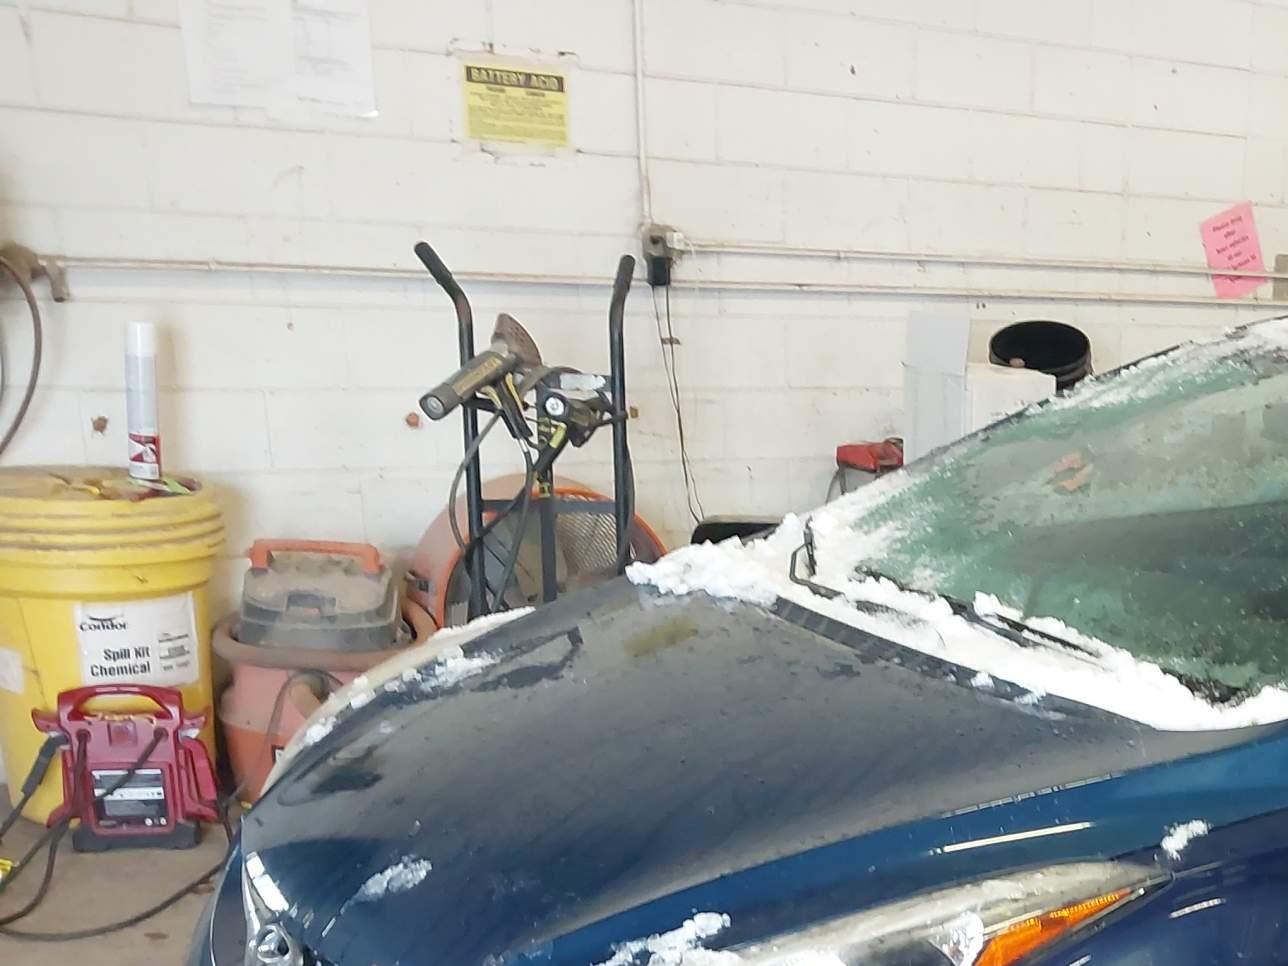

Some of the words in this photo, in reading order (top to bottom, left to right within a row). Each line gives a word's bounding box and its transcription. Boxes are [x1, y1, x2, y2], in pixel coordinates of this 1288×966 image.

[471, 68, 525, 88] BATTERY
[103, 647, 131, 662] Spill
[134, 645, 151, 659] Kit
[90, 661, 151, 677] Chemical
